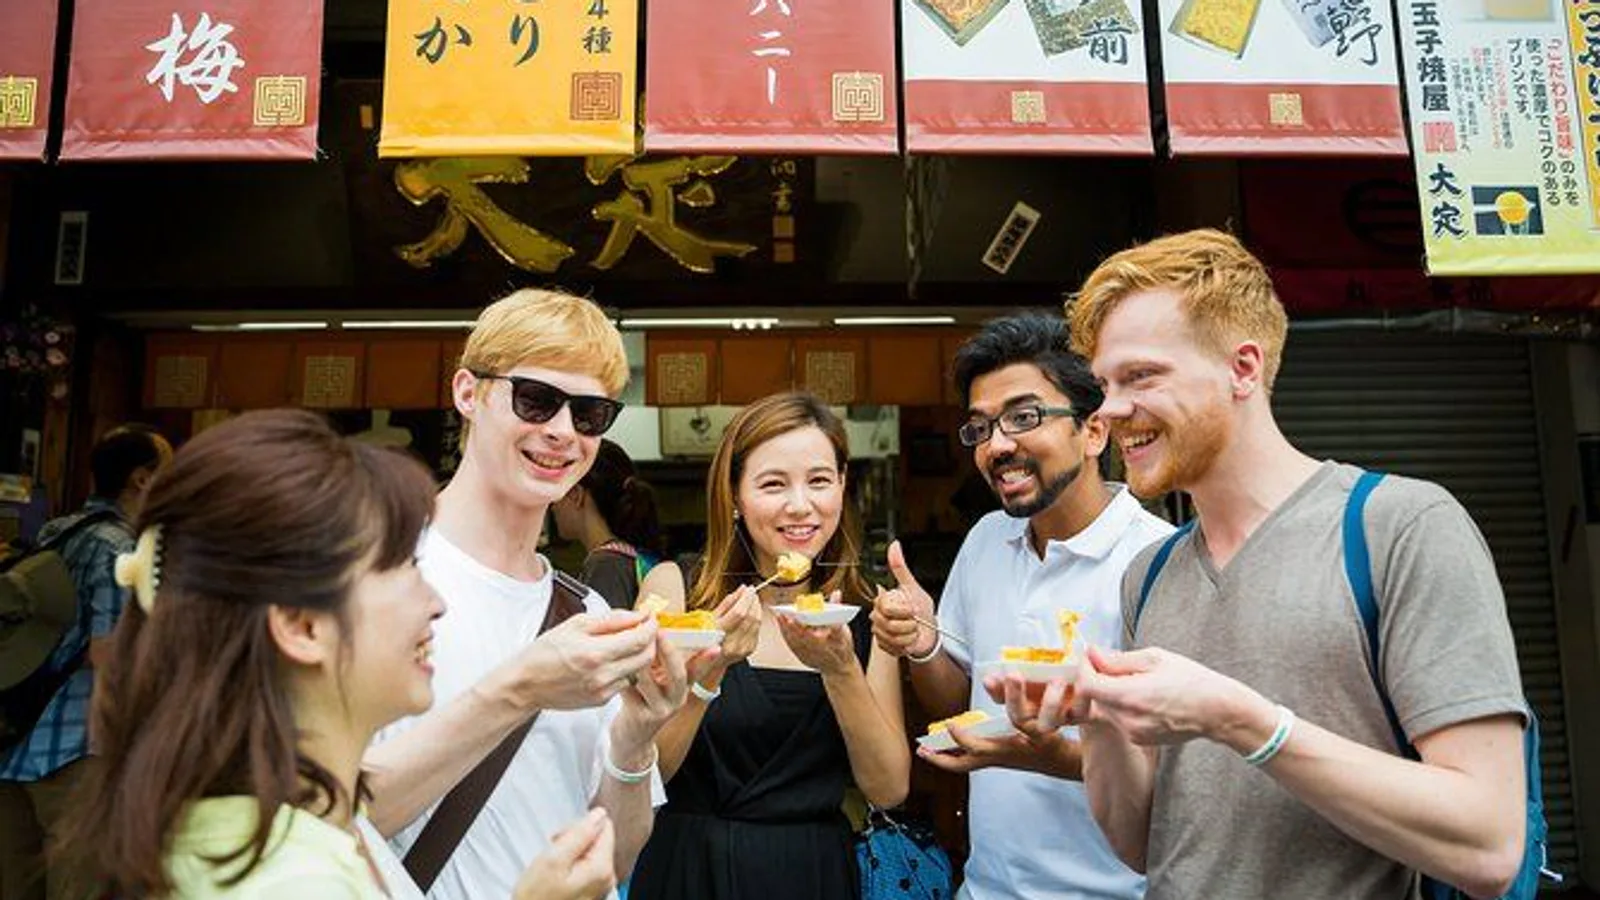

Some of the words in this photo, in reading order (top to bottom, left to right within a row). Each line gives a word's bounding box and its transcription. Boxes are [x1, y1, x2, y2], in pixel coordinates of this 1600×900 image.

[145, 12, 245, 104] 梅
[413, 16, 472, 64] か
[509, 0, 540, 67] り
[583, 0, 613, 54] 4種
[1079, 0, 1132, 65] 前
[1328, 0, 1383, 66] 野
[1411, 3, 1450, 111] 玉子焼屋
[1428, 162, 1464, 236] 大定
